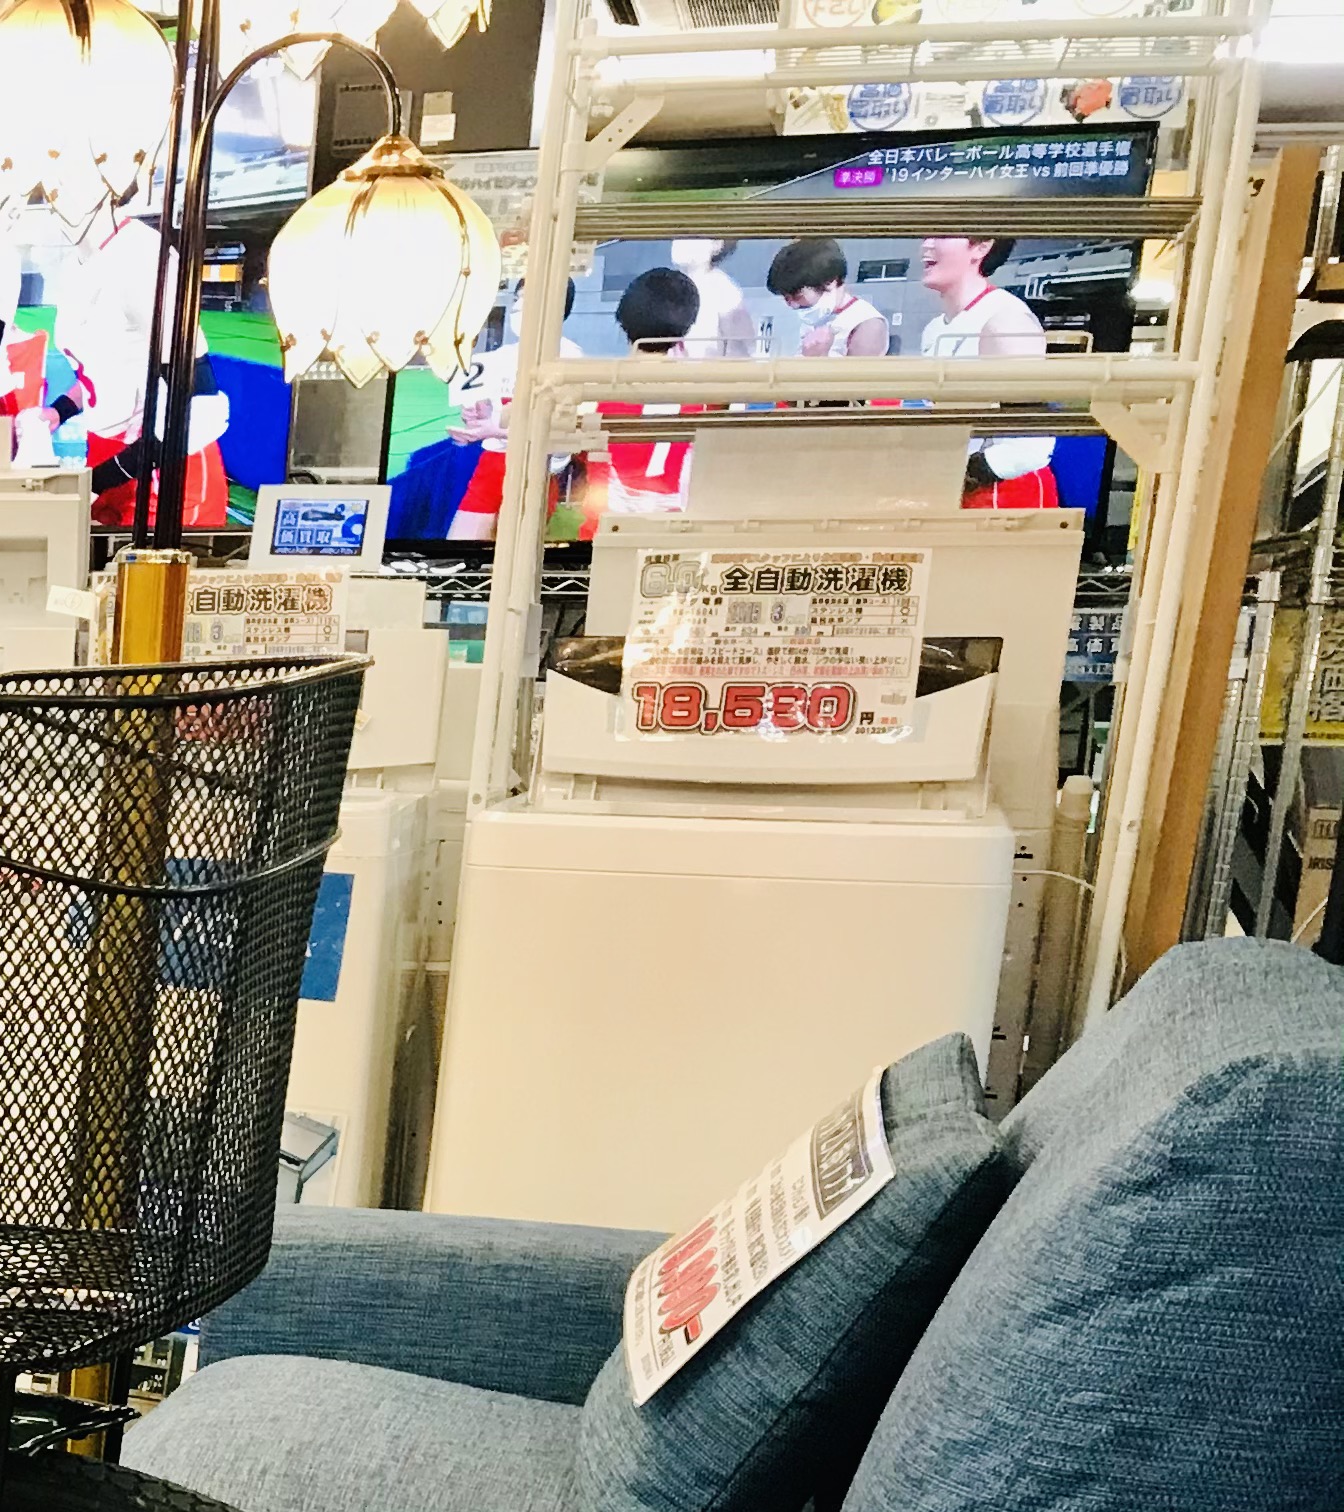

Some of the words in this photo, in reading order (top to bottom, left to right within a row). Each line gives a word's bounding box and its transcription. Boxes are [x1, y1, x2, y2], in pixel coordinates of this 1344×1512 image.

[868, 142, 1131, 166] 全日本バレーボール高等学校選手権
[1032, 166, 1050, 179] vs
[1054, 161, 1129, 179] 前回準優勝
[723, 565, 911, 593] 全自動洗濯機
[860, 711, 874, 725] 円
